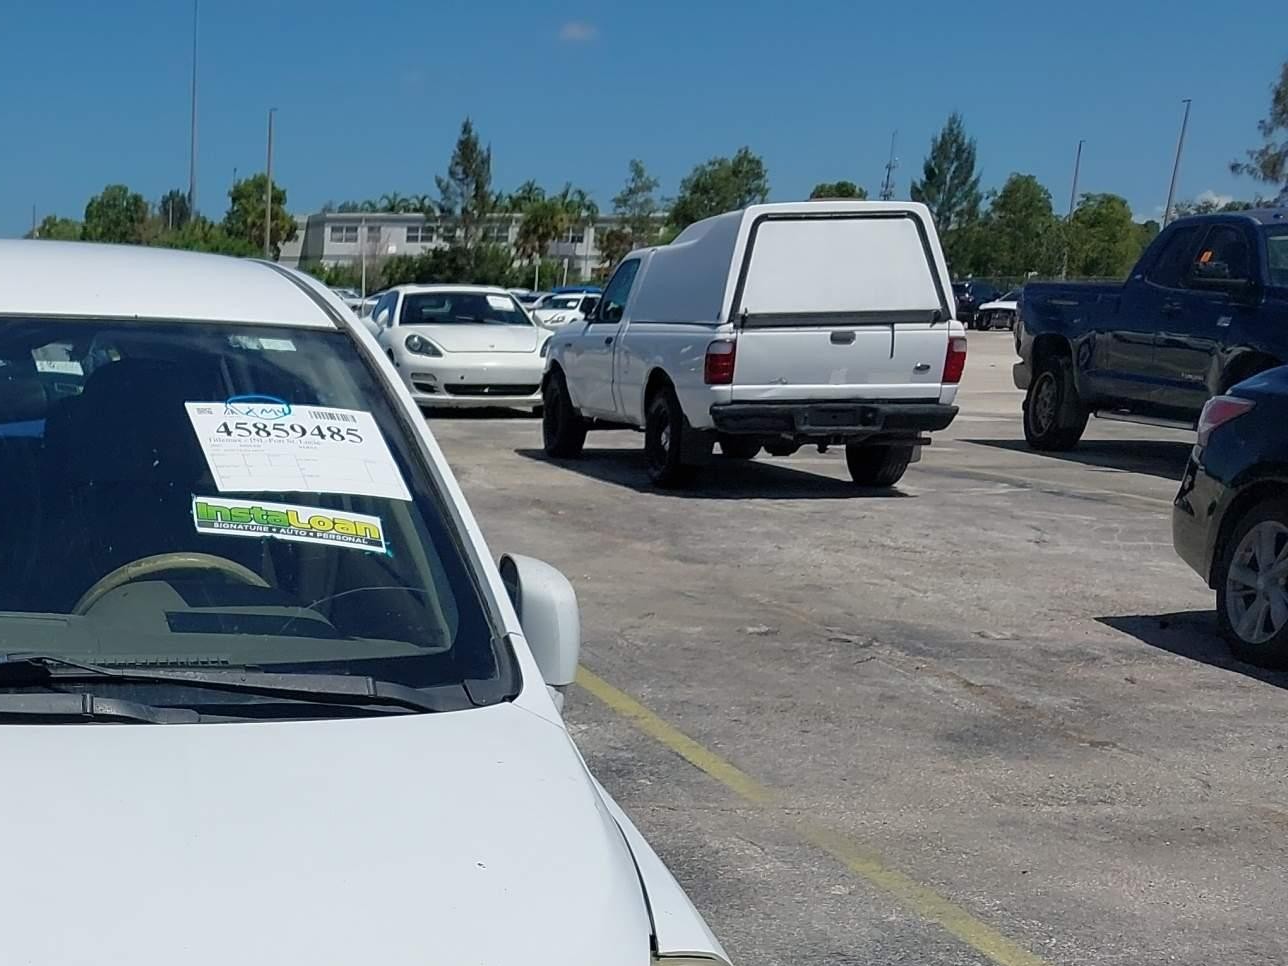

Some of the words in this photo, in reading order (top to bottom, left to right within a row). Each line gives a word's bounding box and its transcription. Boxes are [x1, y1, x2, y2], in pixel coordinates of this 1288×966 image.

[215, 421, 363, 444] 45859485
[195, 502, 380, 540] InstaLoan
[213, 522, 269, 532] SIGNATURE
[280, 528, 307, 536] AUTO
[316, 532, 369, 545] PERSONAL
